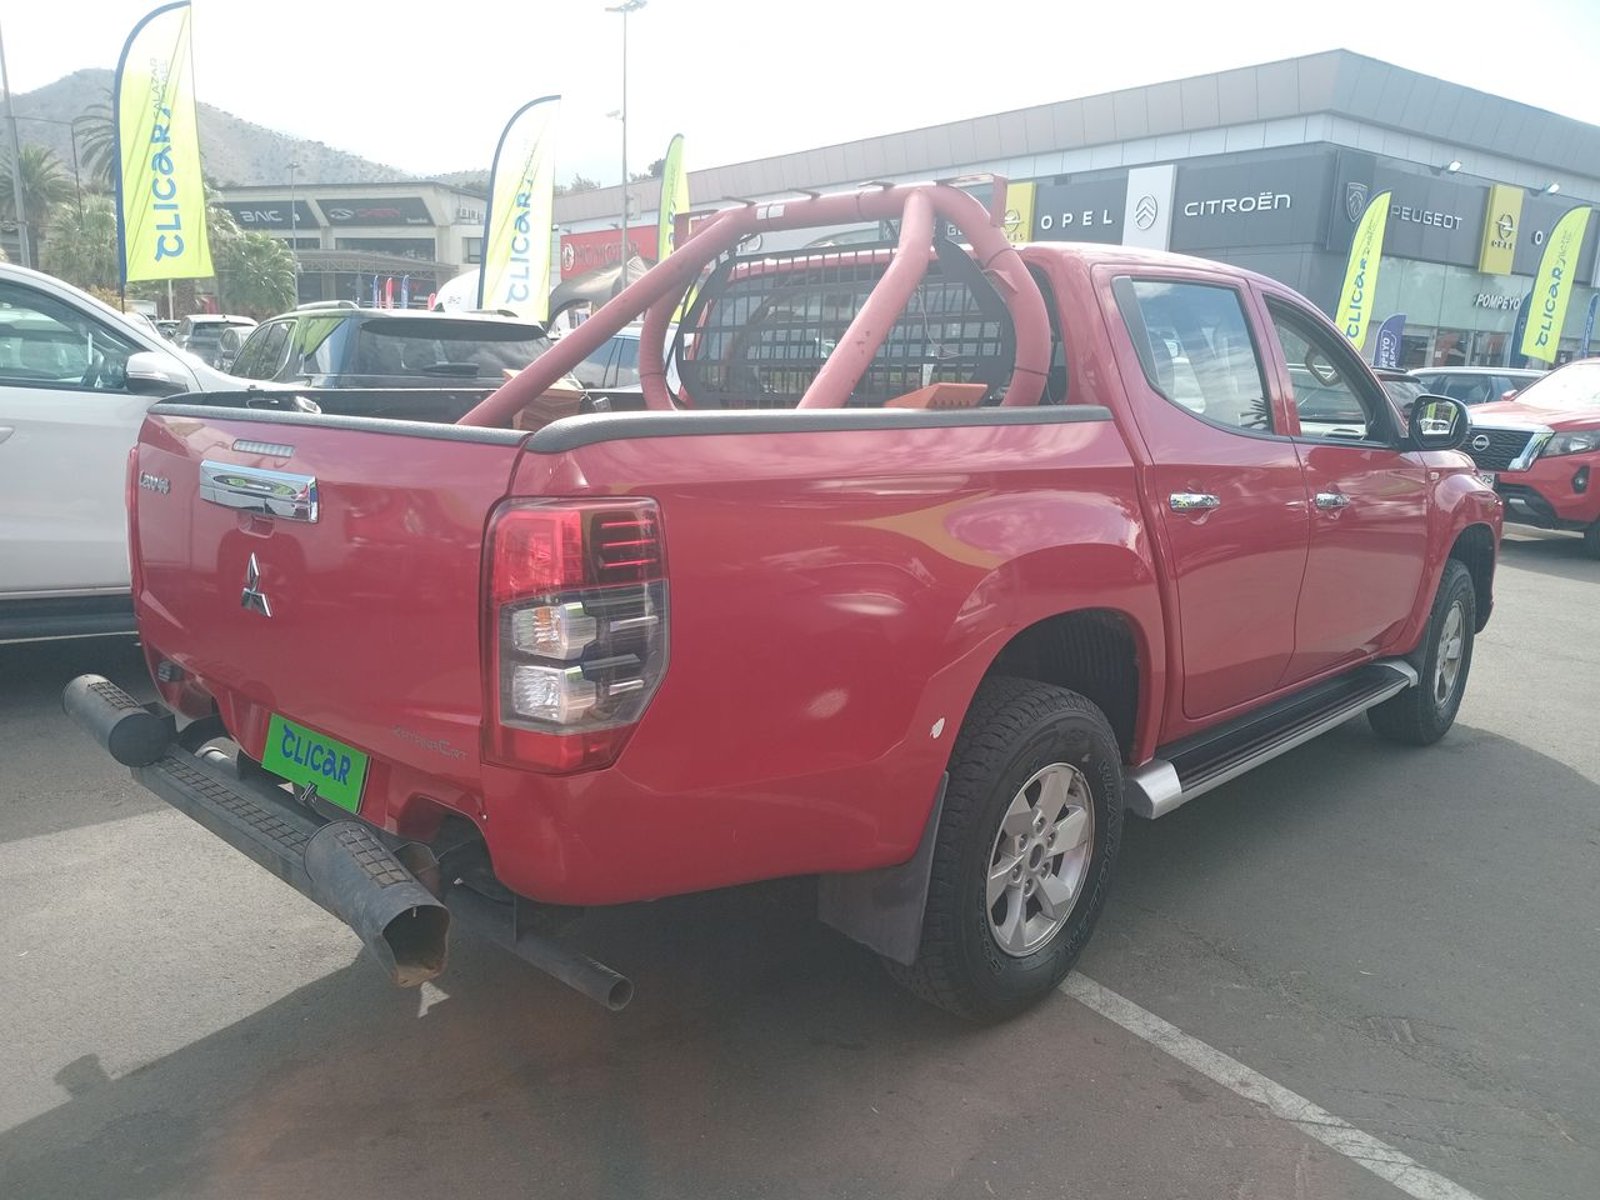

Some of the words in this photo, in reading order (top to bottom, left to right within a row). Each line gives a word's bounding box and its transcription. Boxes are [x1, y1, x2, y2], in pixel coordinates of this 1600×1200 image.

[240, 210, 283, 223] BAIC
[1040, 209, 1113, 230] OPEL
[1389, 204, 1463, 230] PEUGEOT
[1475, 293, 1521, 311] POMPEYO
